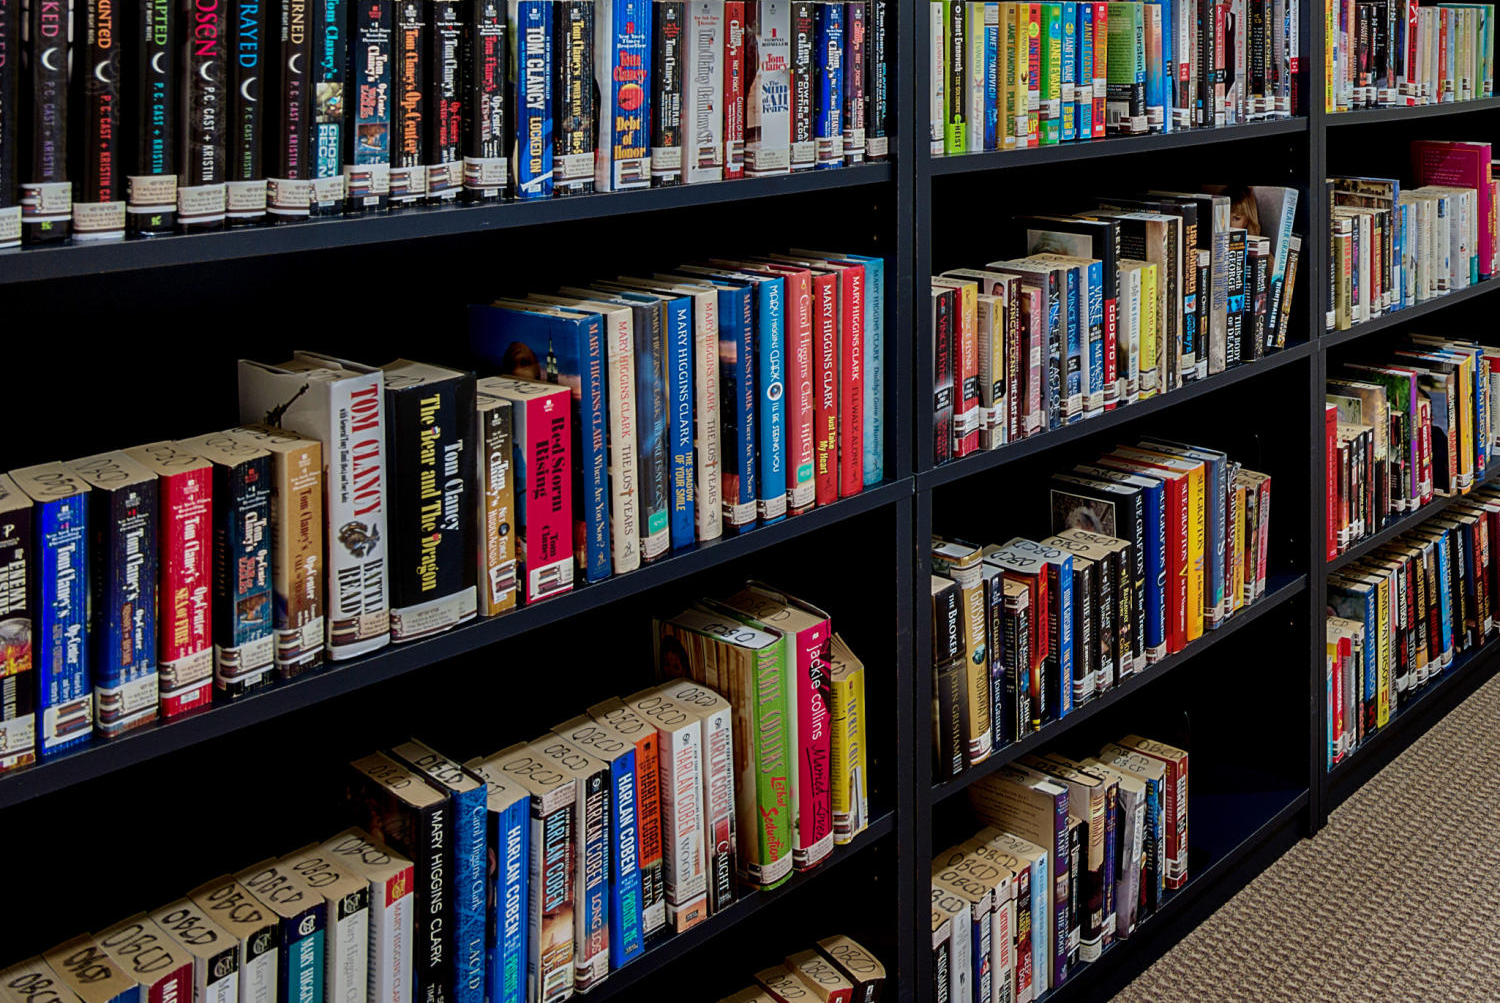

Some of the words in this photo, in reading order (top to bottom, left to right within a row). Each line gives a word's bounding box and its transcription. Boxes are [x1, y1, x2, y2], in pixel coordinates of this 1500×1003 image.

[526, 27, 544, 54] TOM
[989, 27, 997, 49] JANET
[525, 56, 544, 110] CLANCY
[989, 51, 997, 99] EVANOVICH
[1028, 119, 1037, 133] UP
[823, 285, 832, 319] MARY
[852, 276, 860, 306] MARY
[618, 321, 627, 352] MARY
[677, 309, 687, 346] MARY
[823, 320, 833, 369] HIGGINS
[852, 307, 860, 347] HIGGINS
[852, 348, 860, 381] CLARK
[1109, 345, 1115, 360] TO
[619, 354, 630, 399] HIGGINS
[678, 348, 689, 401] HIGGINS
[824, 371, 833, 409] CLARK
[350, 384, 379, 432] TOM
[419, 393, 441, 422] The
[620, 401, 631, 438] CLARK
[679, 402, 690, 446] CLARK
[420, 427, 441, 463] Bear
[551, 416, 565, 447] Red
[445, 439, 464, 476] Tom
[535, 440, 549, 501] Rising
[674, 454, 682, 466] OF
[352, 439, 382, 517] CLANCY
[421, 471, 441, 497] and
[552, 454, 565, 513] Storm
[675, 468, 684, 488] YOUR
[420, 499, 442, 529] The
[441, 479, 462, 531] Clancy
[675, 489, 686, 511] SMILE
[416, 533, 442, 592] Dragon
[970, 591, 985, 644] GRISHAM
[1368, 593, 1376, 626] JAMES
[1380, 583, 1389, 617] JAMES
[806, 643, 822, 691] jackie
[1368, 629, 1376, 697] PATTERSON
[1380, 620, 1389, 689] PATTERSON
[603, 709, 645, 734] OBCD
[637, 696, 687, 725] OBCD
[810, 694, 822, 740] collins
[544, 744, 589, 771] OBCD
[1136, 740, 1187, 758] OBCD
[501, 757, 564, 786] OBCD
[617, 774, 634, 822] HARLAN
[431, 810, 443, 848] MARY
[546, 810, 566, 859] HARLAN
[506, 825, 521, 874] HARLAN
[619, 825, 636, 877] COBEN
[430, 853, 443, 914] HIGGINS
[546, 861, 565, 912] COBEN
[504, 878, 519, 935] COBEN
[101, 923, 174, 975] OBCD
[430, 918, 442, 967] CLARK
[830, 945, 875, 973] OBCD
